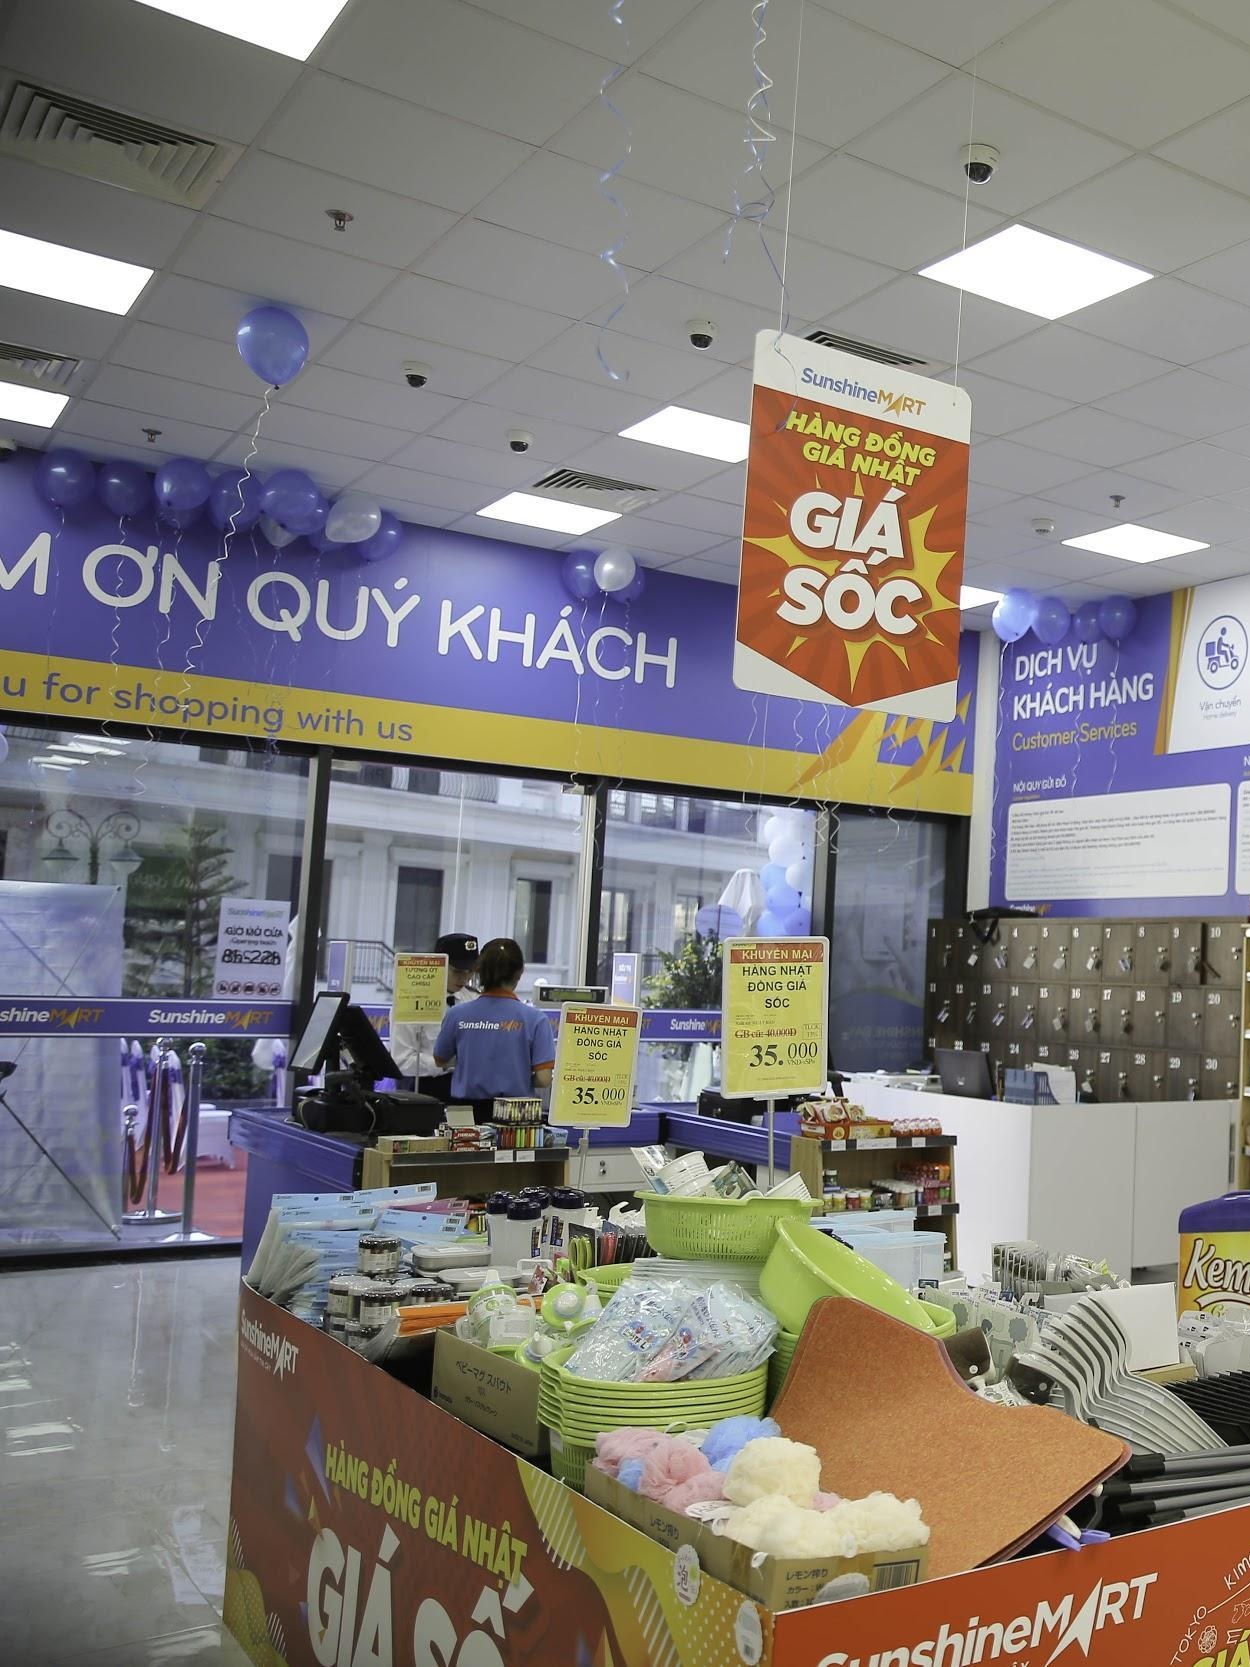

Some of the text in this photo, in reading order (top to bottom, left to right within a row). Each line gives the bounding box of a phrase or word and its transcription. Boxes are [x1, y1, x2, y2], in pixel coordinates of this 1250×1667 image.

[801, 367, 926, 418] SunshineMART
[785, 411, 936, 467] HÀNG ĐỒNG
[802, 440, 921, 489] GIÁ NHẬT
[789, 485, 907, 561] GIÁ
[775, 551, 924, 636] SỐC
[82, 543, 220, 621] ƠN
[246, 570, 421, 648] QUÝ
[437, 599, 679, 689] KHÁCH
[1015, 642, 1098, 685] DỊCH VỤ
[1013, 672, 1155, 721] KHÁCH HÀNG
[43, 672, 101, 705] for
[113, 682, 284, 733] shopping
[297, 707, 364, 736] with
[377, 720, 413, 744] us
[1012, 719, 1138, 752] Customer Services
[1027, 779, 1041, 791] QUY
[931, 928, 936, 937] 1
[958, 928, 964, 937] 2
[1012, 928, 1018, 938] 4
[1042, 928, 1048, 938] 5
[1073, 928, 1079, 938] 6
[1106, 928, 1112, 938] 7
[1139, 927, 1145, 937] 8
[1174, 928, 1180, 938] 9
[1210, 927, 1221, 938] 10
[792, 949, 812, 961] MẠI
[956, 984, 963, 993] 12
[983, 985, 991, 995] 13
[1011, 986, 1019, 996] 14
[1039, 988, 1048, 998] 15
[1072, 988, 1081, 999] 16
[1103, 989, 1112, 1000] 17
[1136, 991, 1146, 1001] 18
[1172, 992, 1182, 1002] 19
[1208, 993, 1220, 1004] 20
[148, 1008, 274, 1031] SunshineMART
[458, 1020, 523, 1031] SunshineMART
[954, 1040, 964, 1050] 22
[981, 1042, 990, 1052] 23
[1009, 1043, 1020, 1054] 24
[1039, 1046, 1049, 1057] 25
[1069, 1050, 1079, 1060] 26
[1101, 1052, 1111, 1063] 27
[1135, 1054, 1146, 1065] 28
[1170, 1058, 1180, 1068] 29
[1206, 1059, 1217, 1070] 30
[241, 1307, 299, 1382] SunshineMART
[325, 1440, 528, 1589] HÀNG ĐỒNG GIÁ NHẬT
[307, 1523, 401, 1667] GIÁ
[1170, 1606, 1208, 1665] TOKYO
